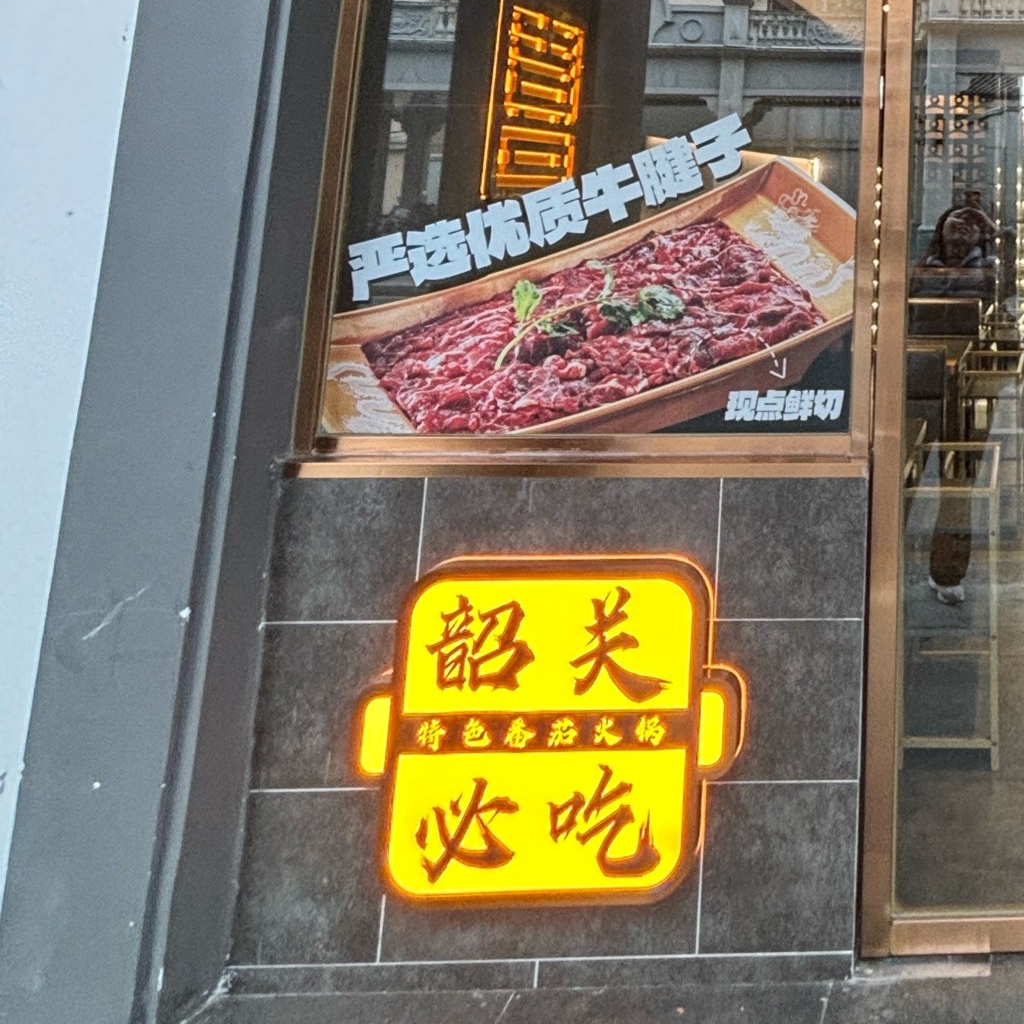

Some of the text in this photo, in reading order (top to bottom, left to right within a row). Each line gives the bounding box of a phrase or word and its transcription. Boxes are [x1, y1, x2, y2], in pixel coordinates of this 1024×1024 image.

[348, 113, 752, 302] 严选优质牛腱子
[724, 389, 845, 422] 现点鲜切
[426, 586, 673, 703] 韶关
[415, 716, 667, 752] 特色番茄火锅
[415, 763, 662, 884] 必吃
